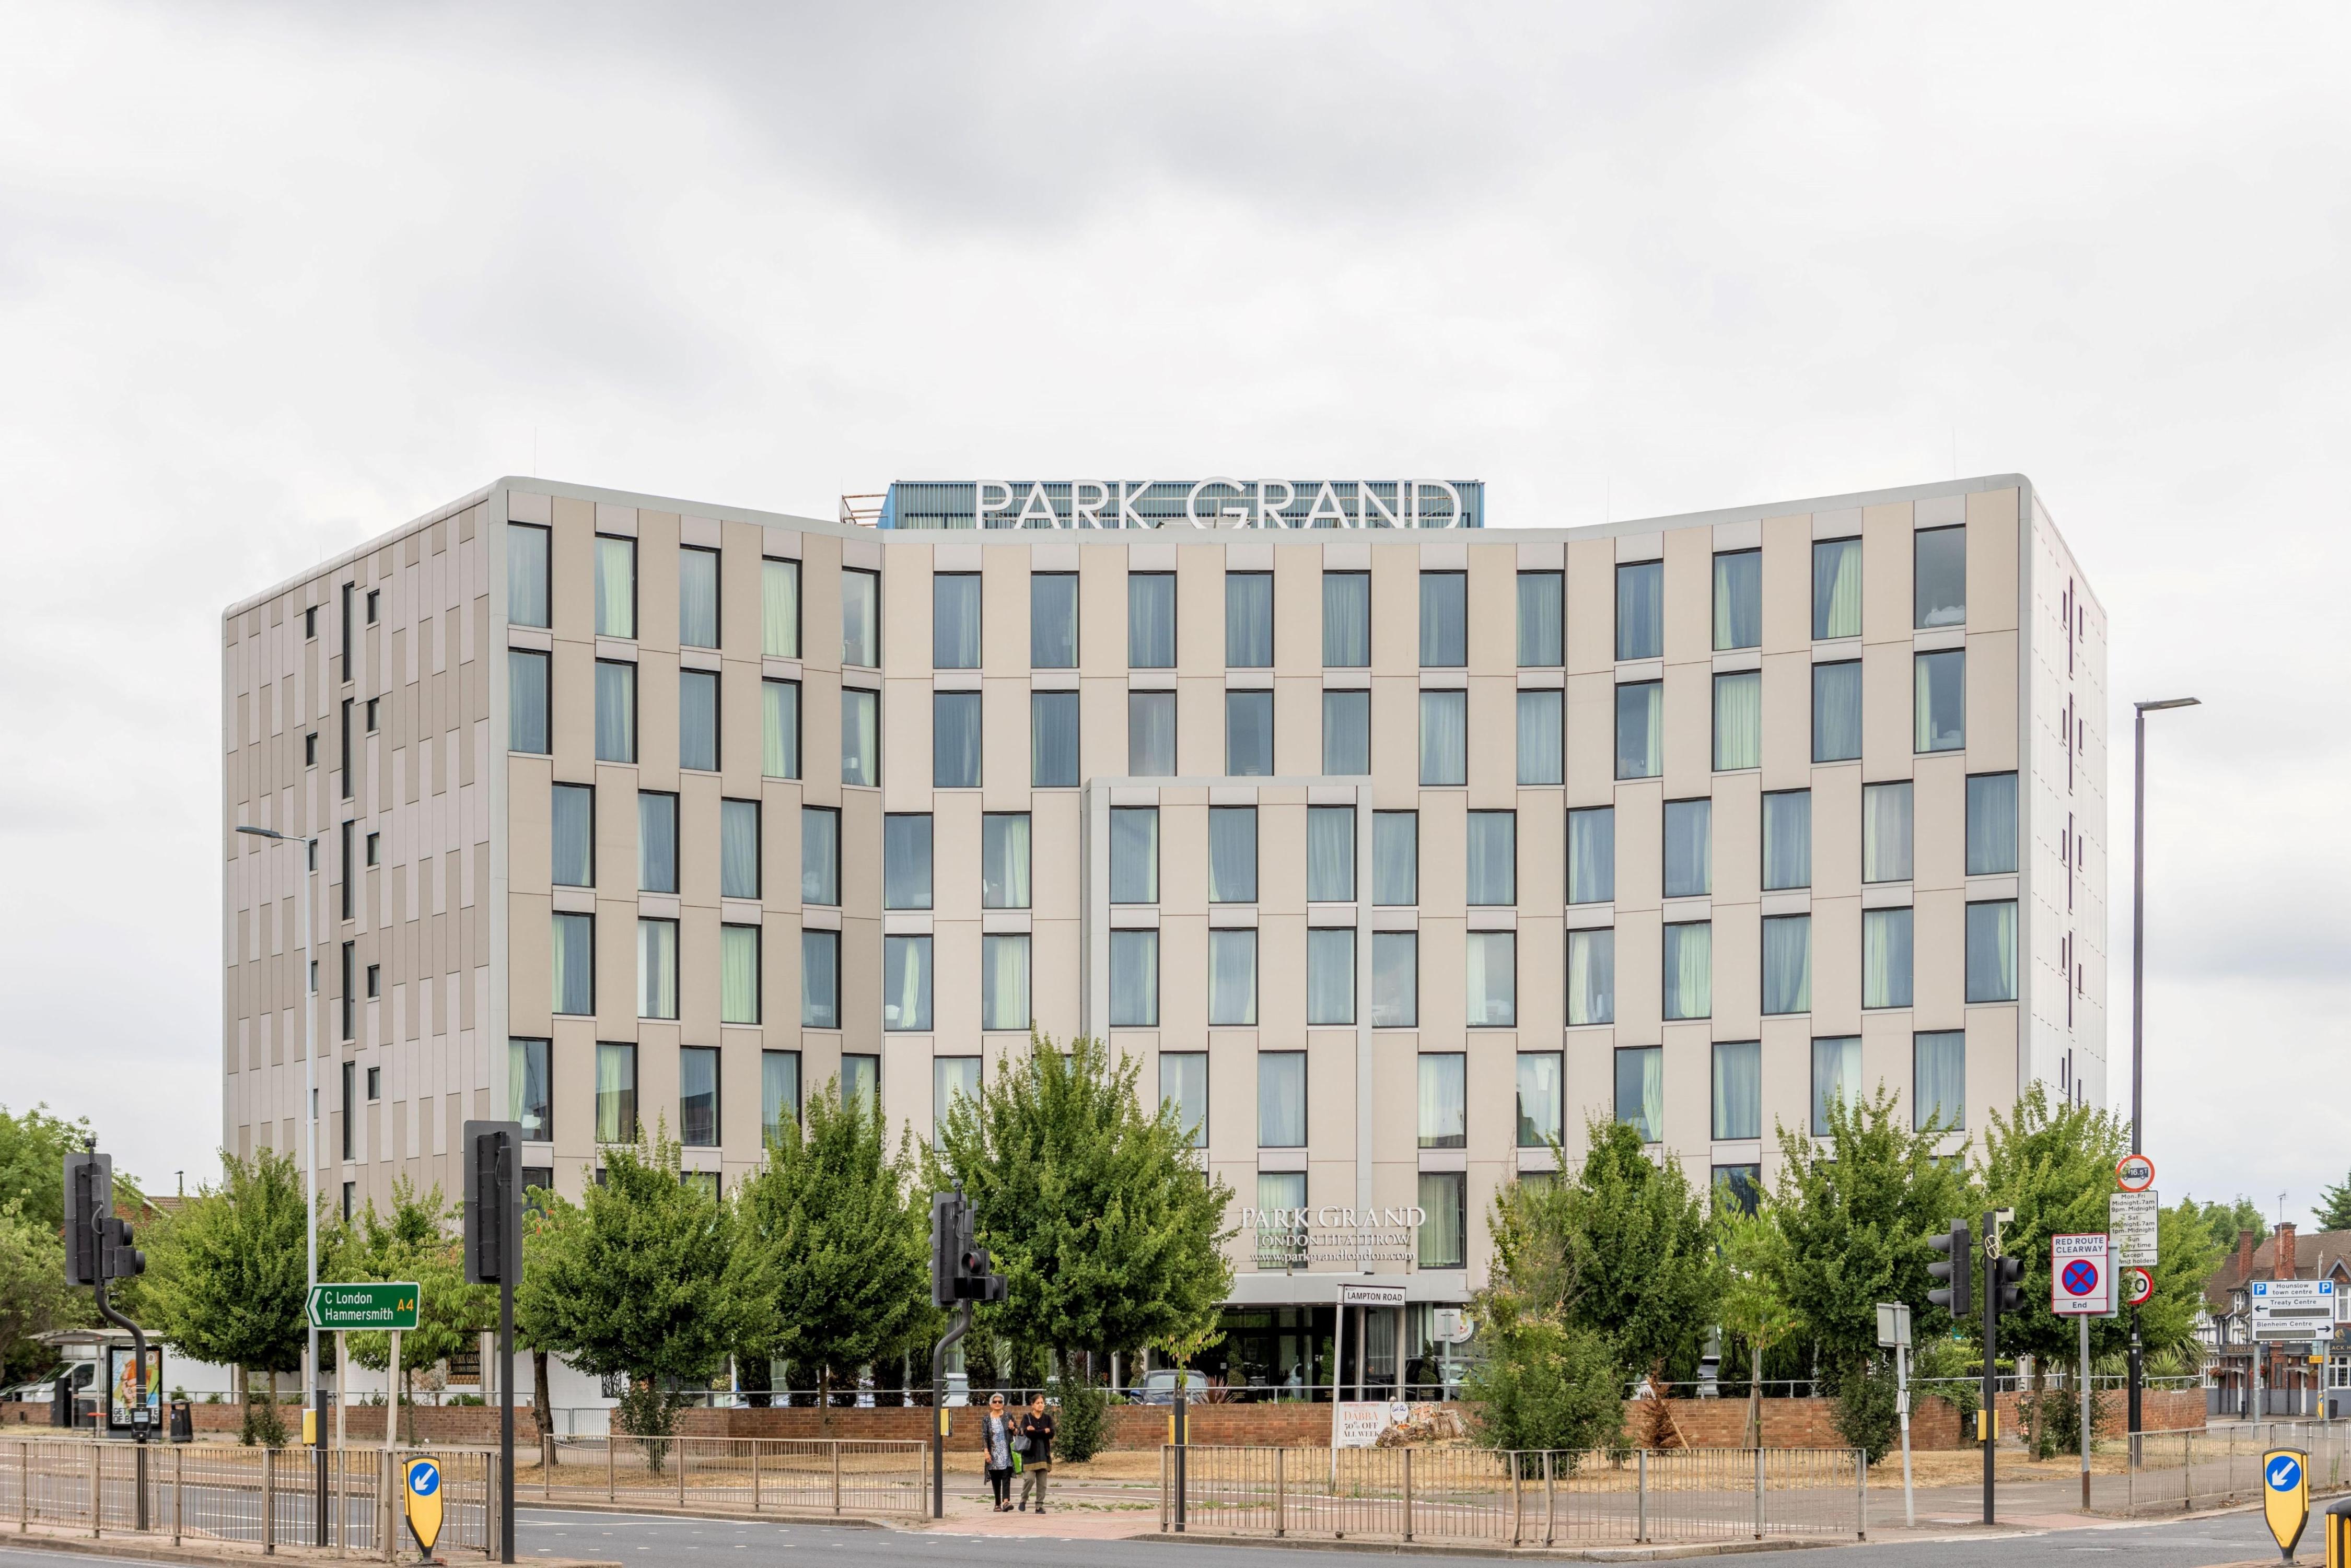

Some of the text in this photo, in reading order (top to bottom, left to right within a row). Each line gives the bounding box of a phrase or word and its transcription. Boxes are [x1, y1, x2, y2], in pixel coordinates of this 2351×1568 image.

[976, 476, 1462, 529] PARK GRAND
[1240, 1206, 1426, 1228] PARK GRAND
[1254, 1233, 1410, 1246] LONDON HEATHROW
[2056, 1245, 2103, 1254] CLEARWAY
[1250, 1249, 1415, 1264] www.parkgrandlondon.com
[325, 1291, 372, 1304] C London
[397, 1298, 414, 1312] A4
[325, 1307, 393, 1320] Hammersmith
[467, 1354, 480, 1364] GRAN
[1344, 1411, 1378, 1420] DABBA
